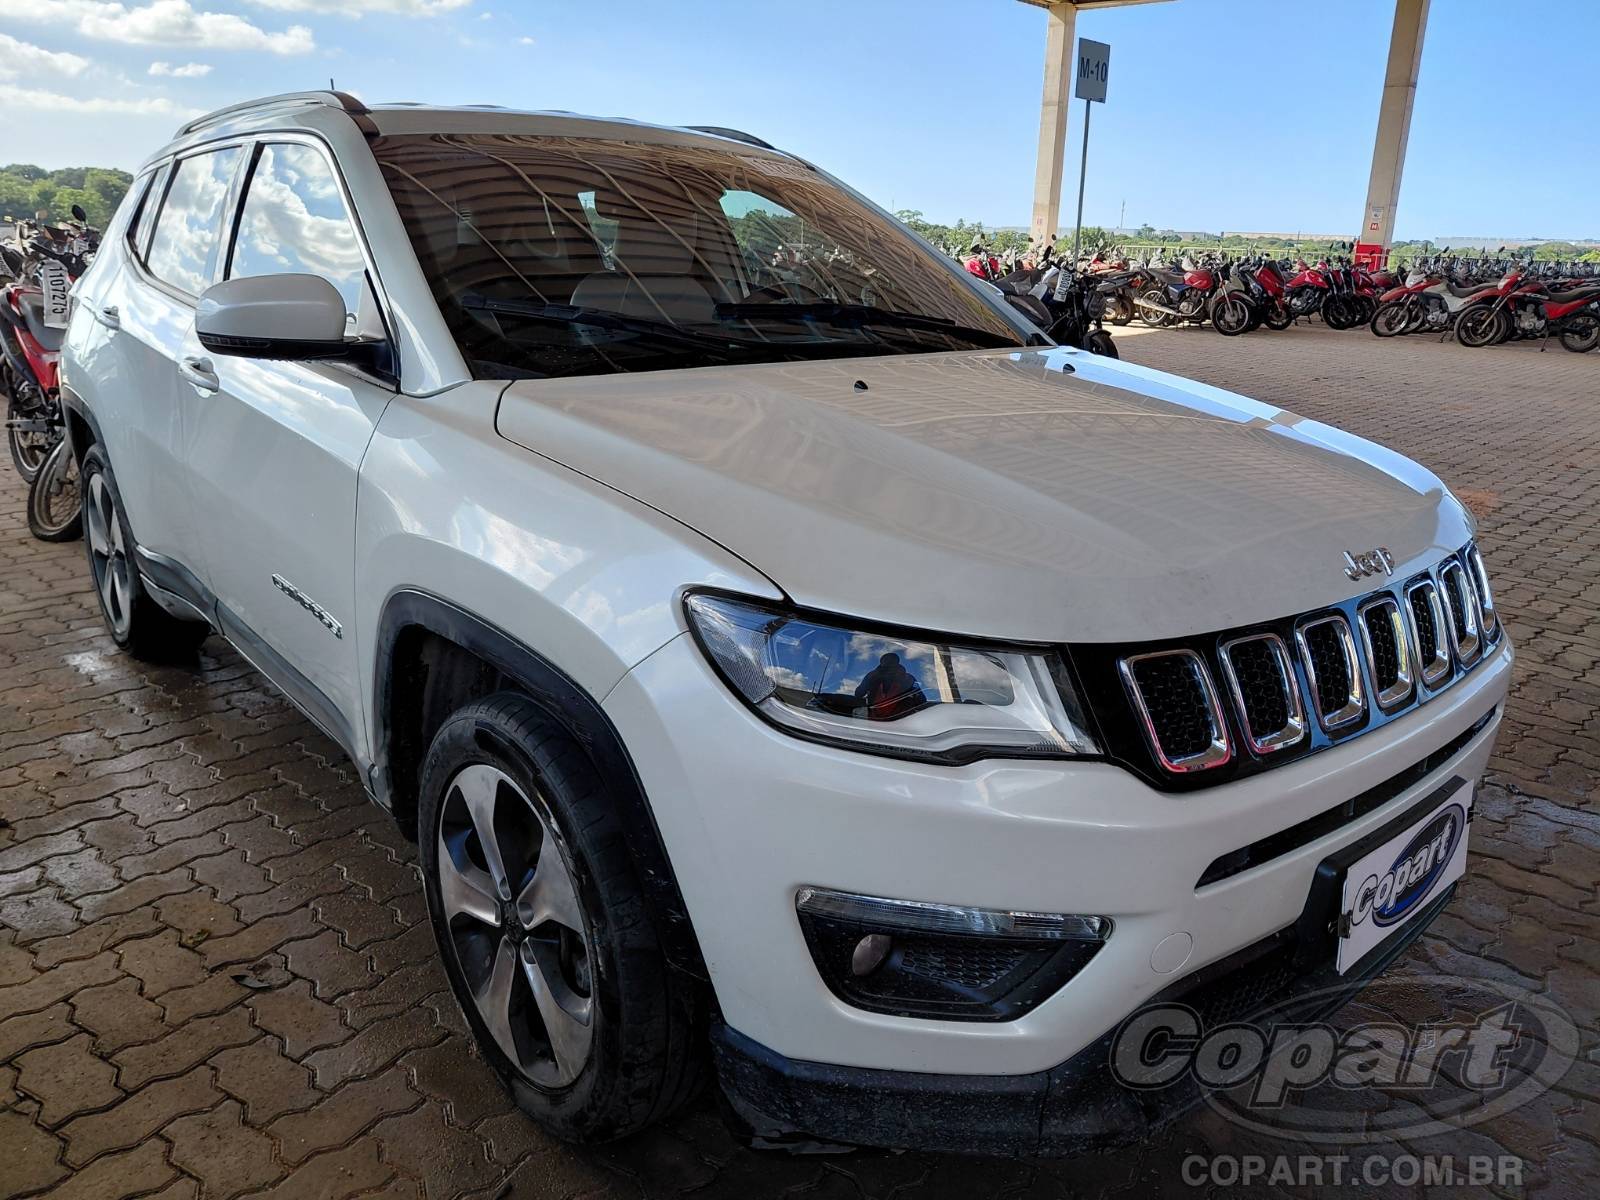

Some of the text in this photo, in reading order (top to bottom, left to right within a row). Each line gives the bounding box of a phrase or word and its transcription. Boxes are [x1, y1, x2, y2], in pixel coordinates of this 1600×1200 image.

[1080, 57, 1108, 82] M-10
[49, 267, 68, 314] 1107275
[1343, 547, 1395, 581] Jeep
[1351, 811, 1454, 926] Copart
